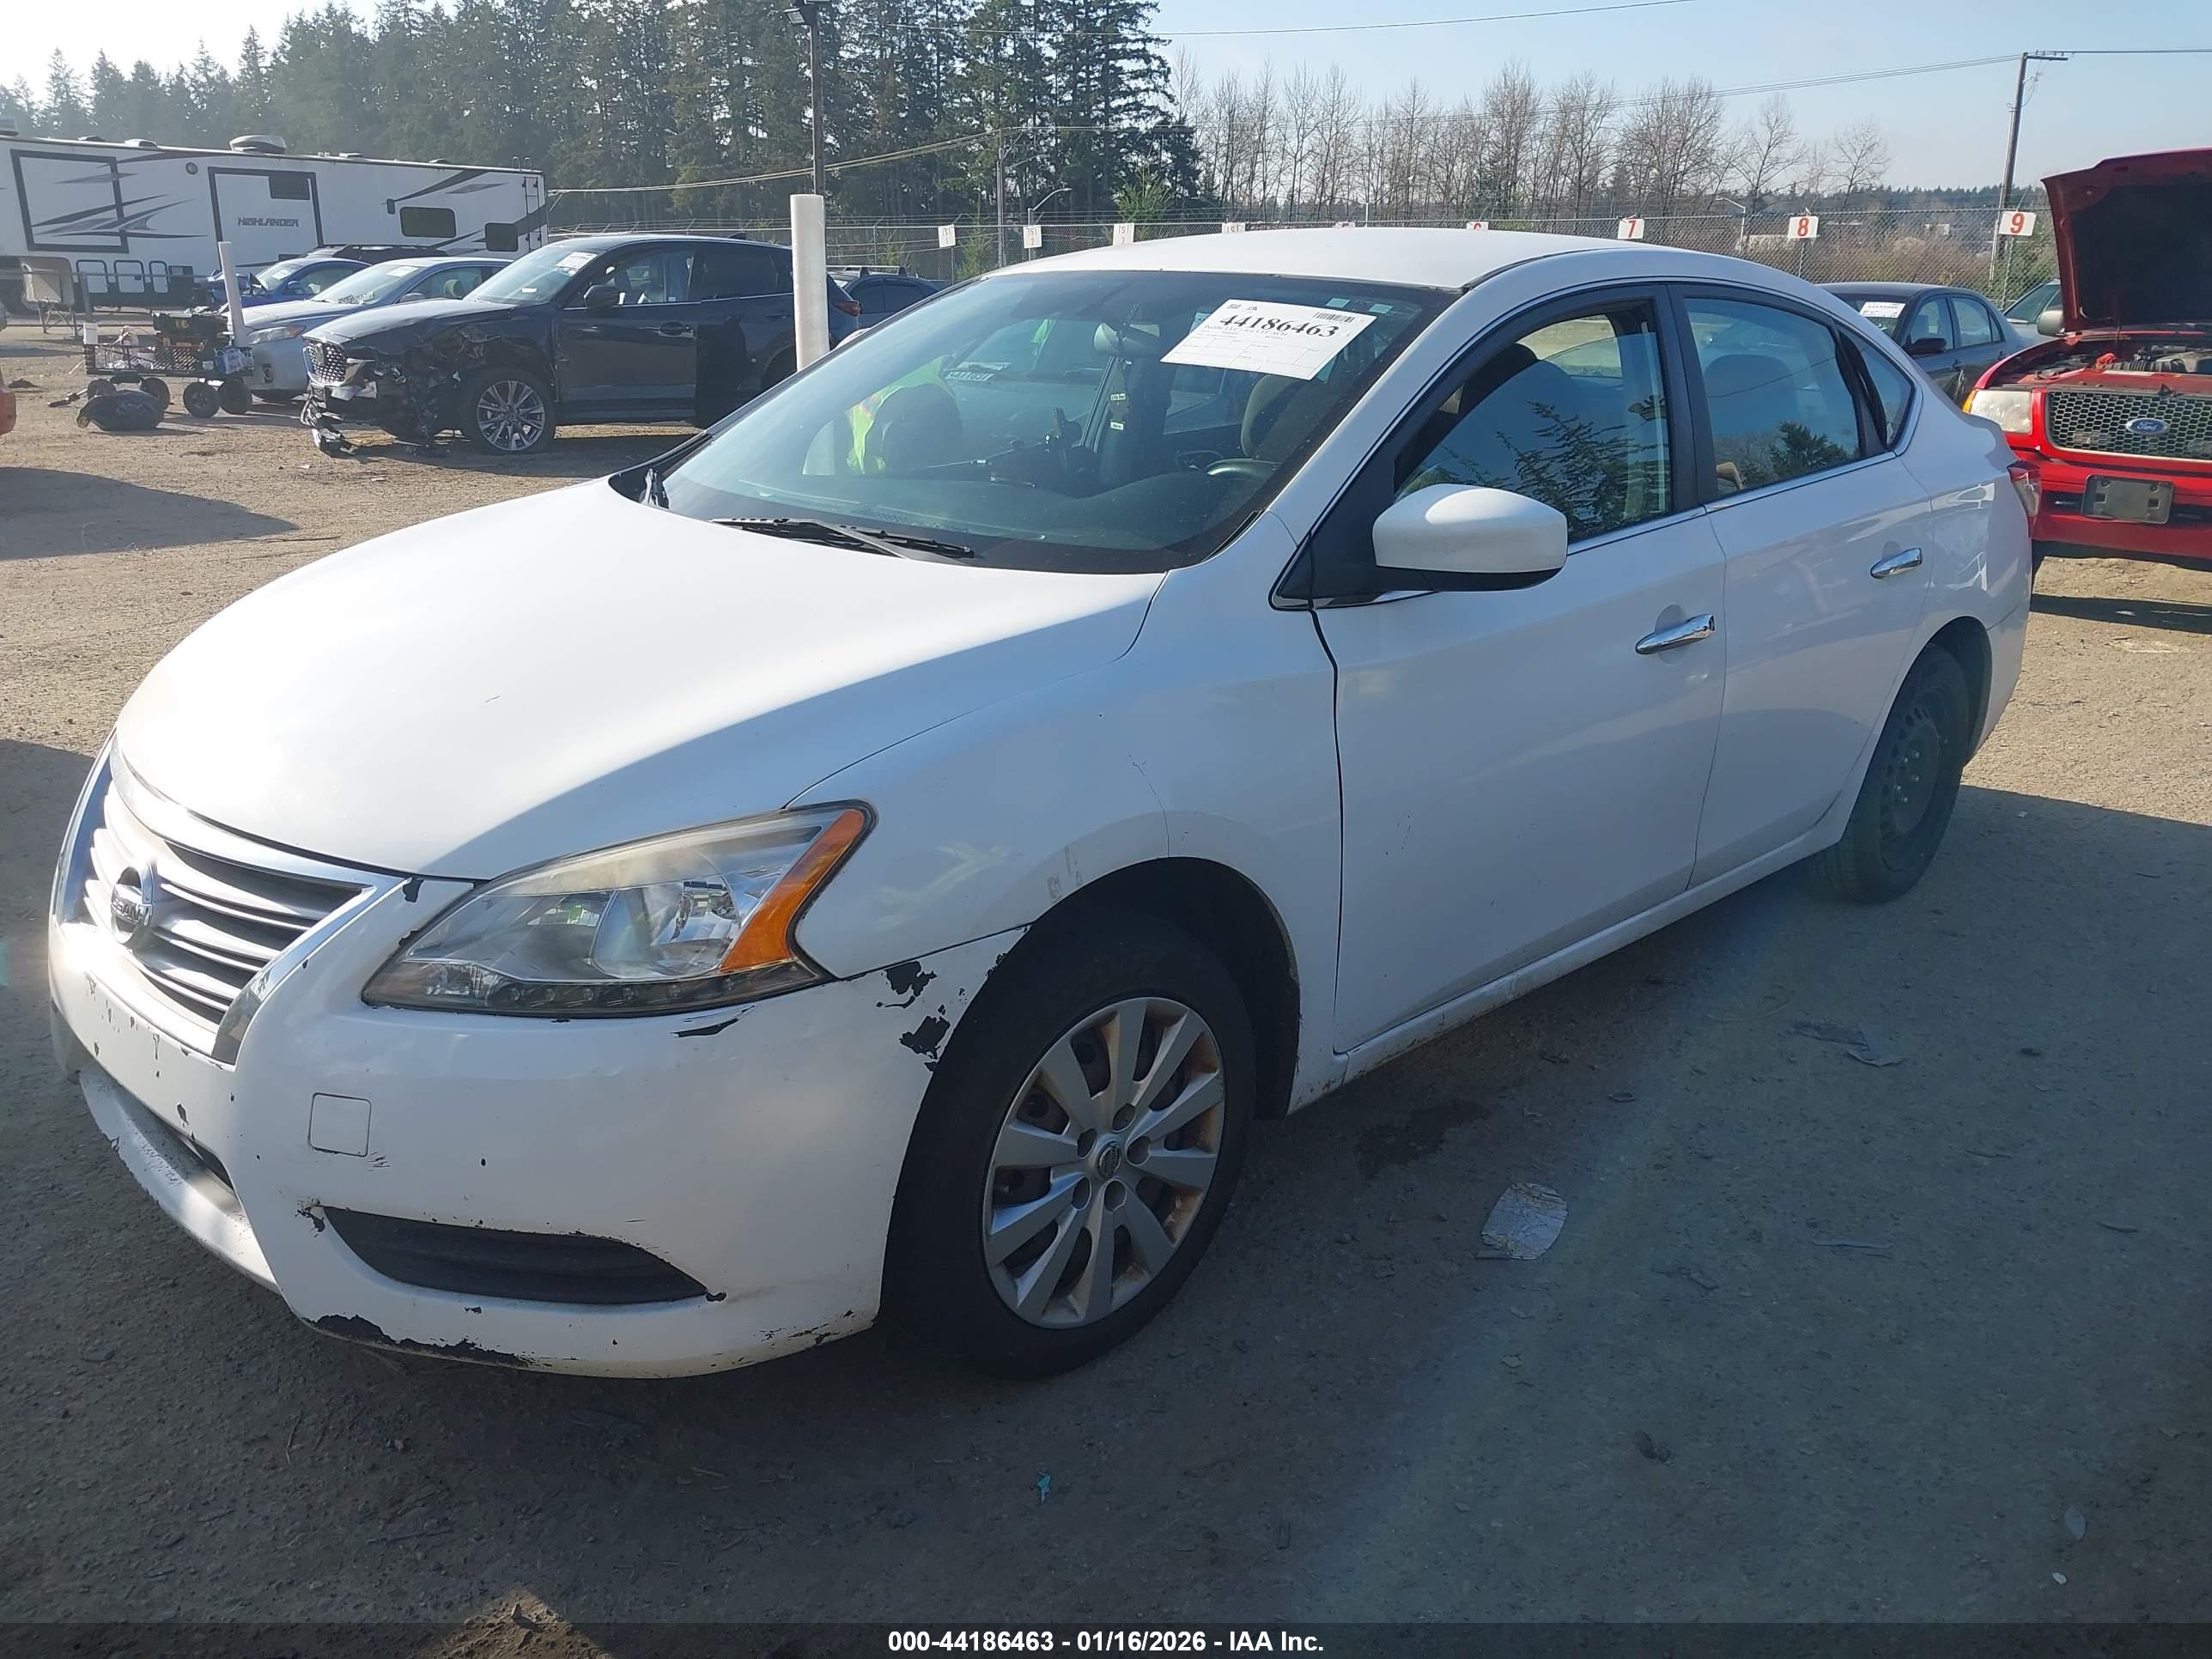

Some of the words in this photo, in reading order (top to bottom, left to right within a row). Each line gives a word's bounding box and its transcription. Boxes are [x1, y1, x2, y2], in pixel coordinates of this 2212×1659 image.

[237, 217, 299, 228] HIGHLANDER
[1628, 220, 1637, 238] 7
[1797, 217, 1810, 237] 8
[2010, 213, 2025, 234] 9
[1219, 314, 1340, 337] 44186463
[2136, 421, 2159, 431] Ford
